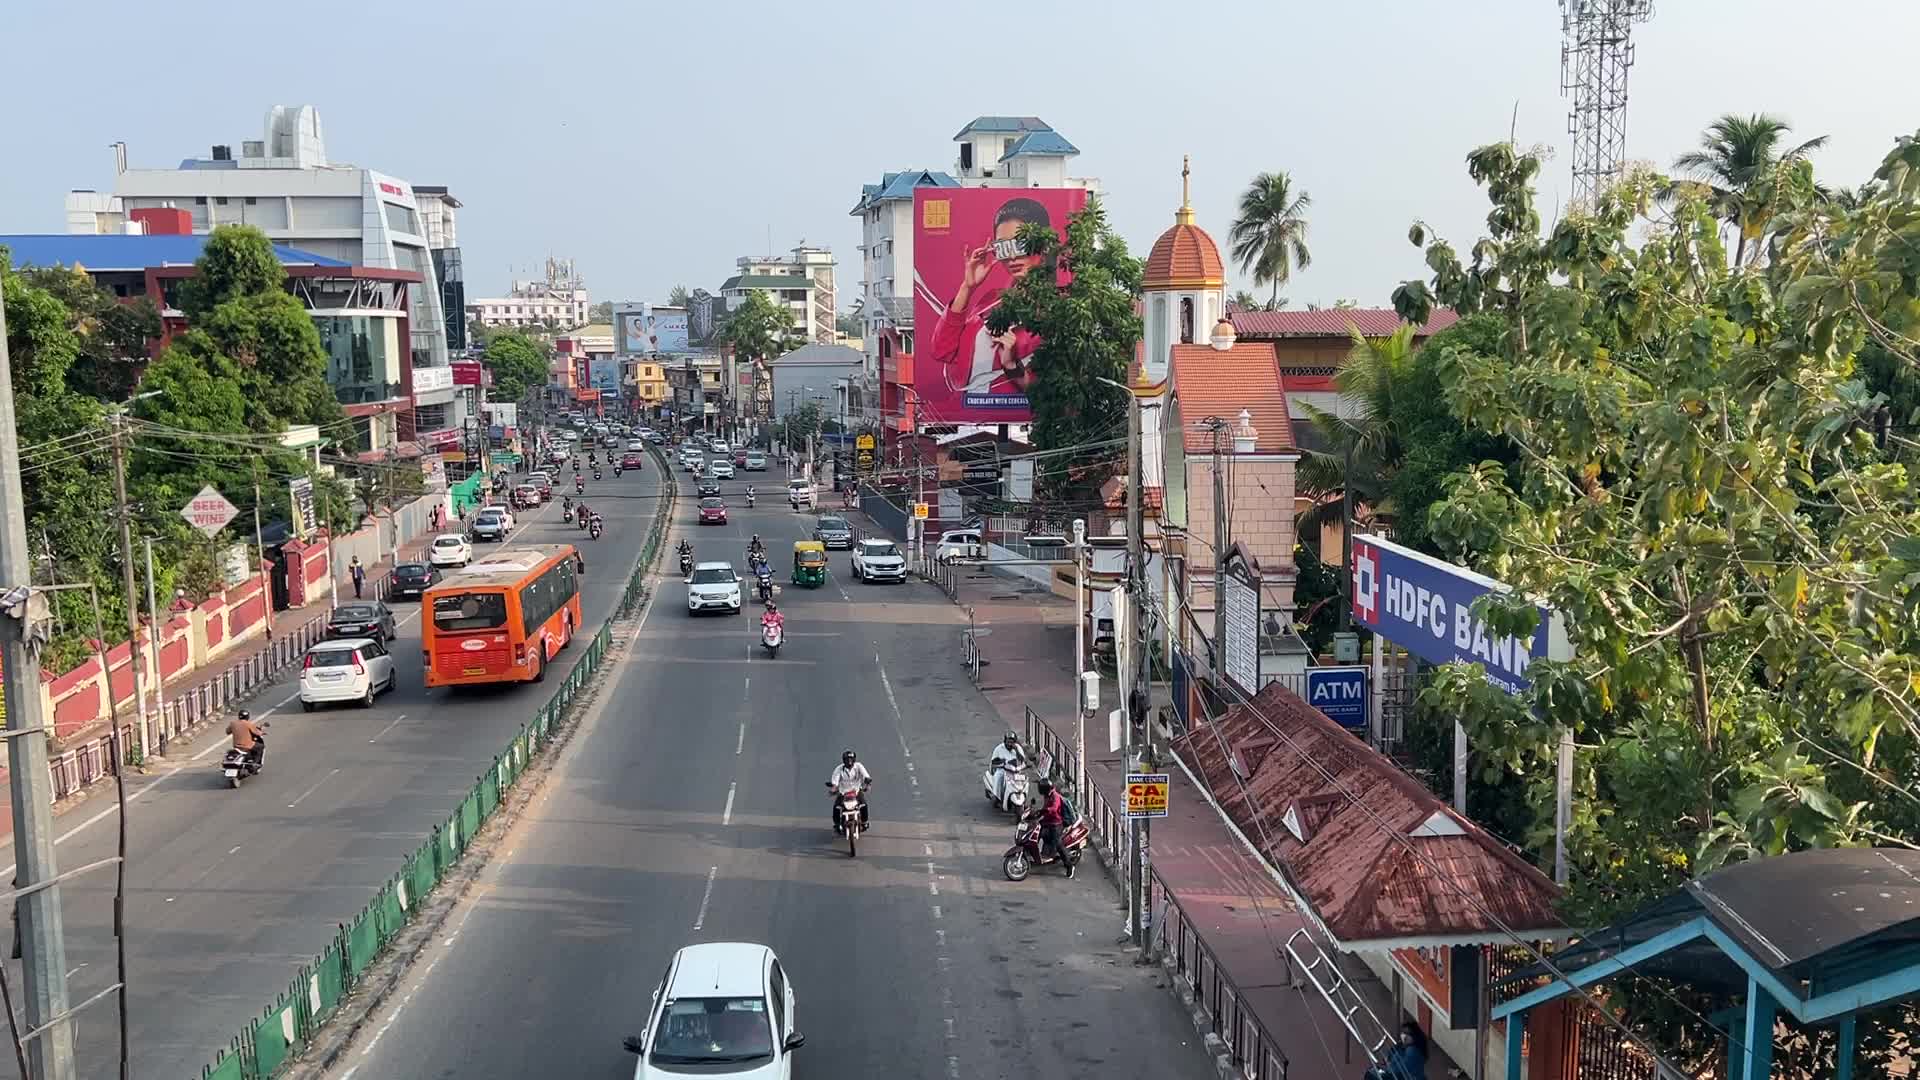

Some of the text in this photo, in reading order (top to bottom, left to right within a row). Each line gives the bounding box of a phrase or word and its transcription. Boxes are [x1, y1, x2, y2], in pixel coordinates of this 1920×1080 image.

[967, 397, 1029, 405] CHOCOLATE WITH CEREALS
[192, 500, 225, 511] BEER
[193, 514, 225, 524] WINE
[1386, 574, 1447, 638] HDFC
[1313, 681, 1362, 700] ATM
